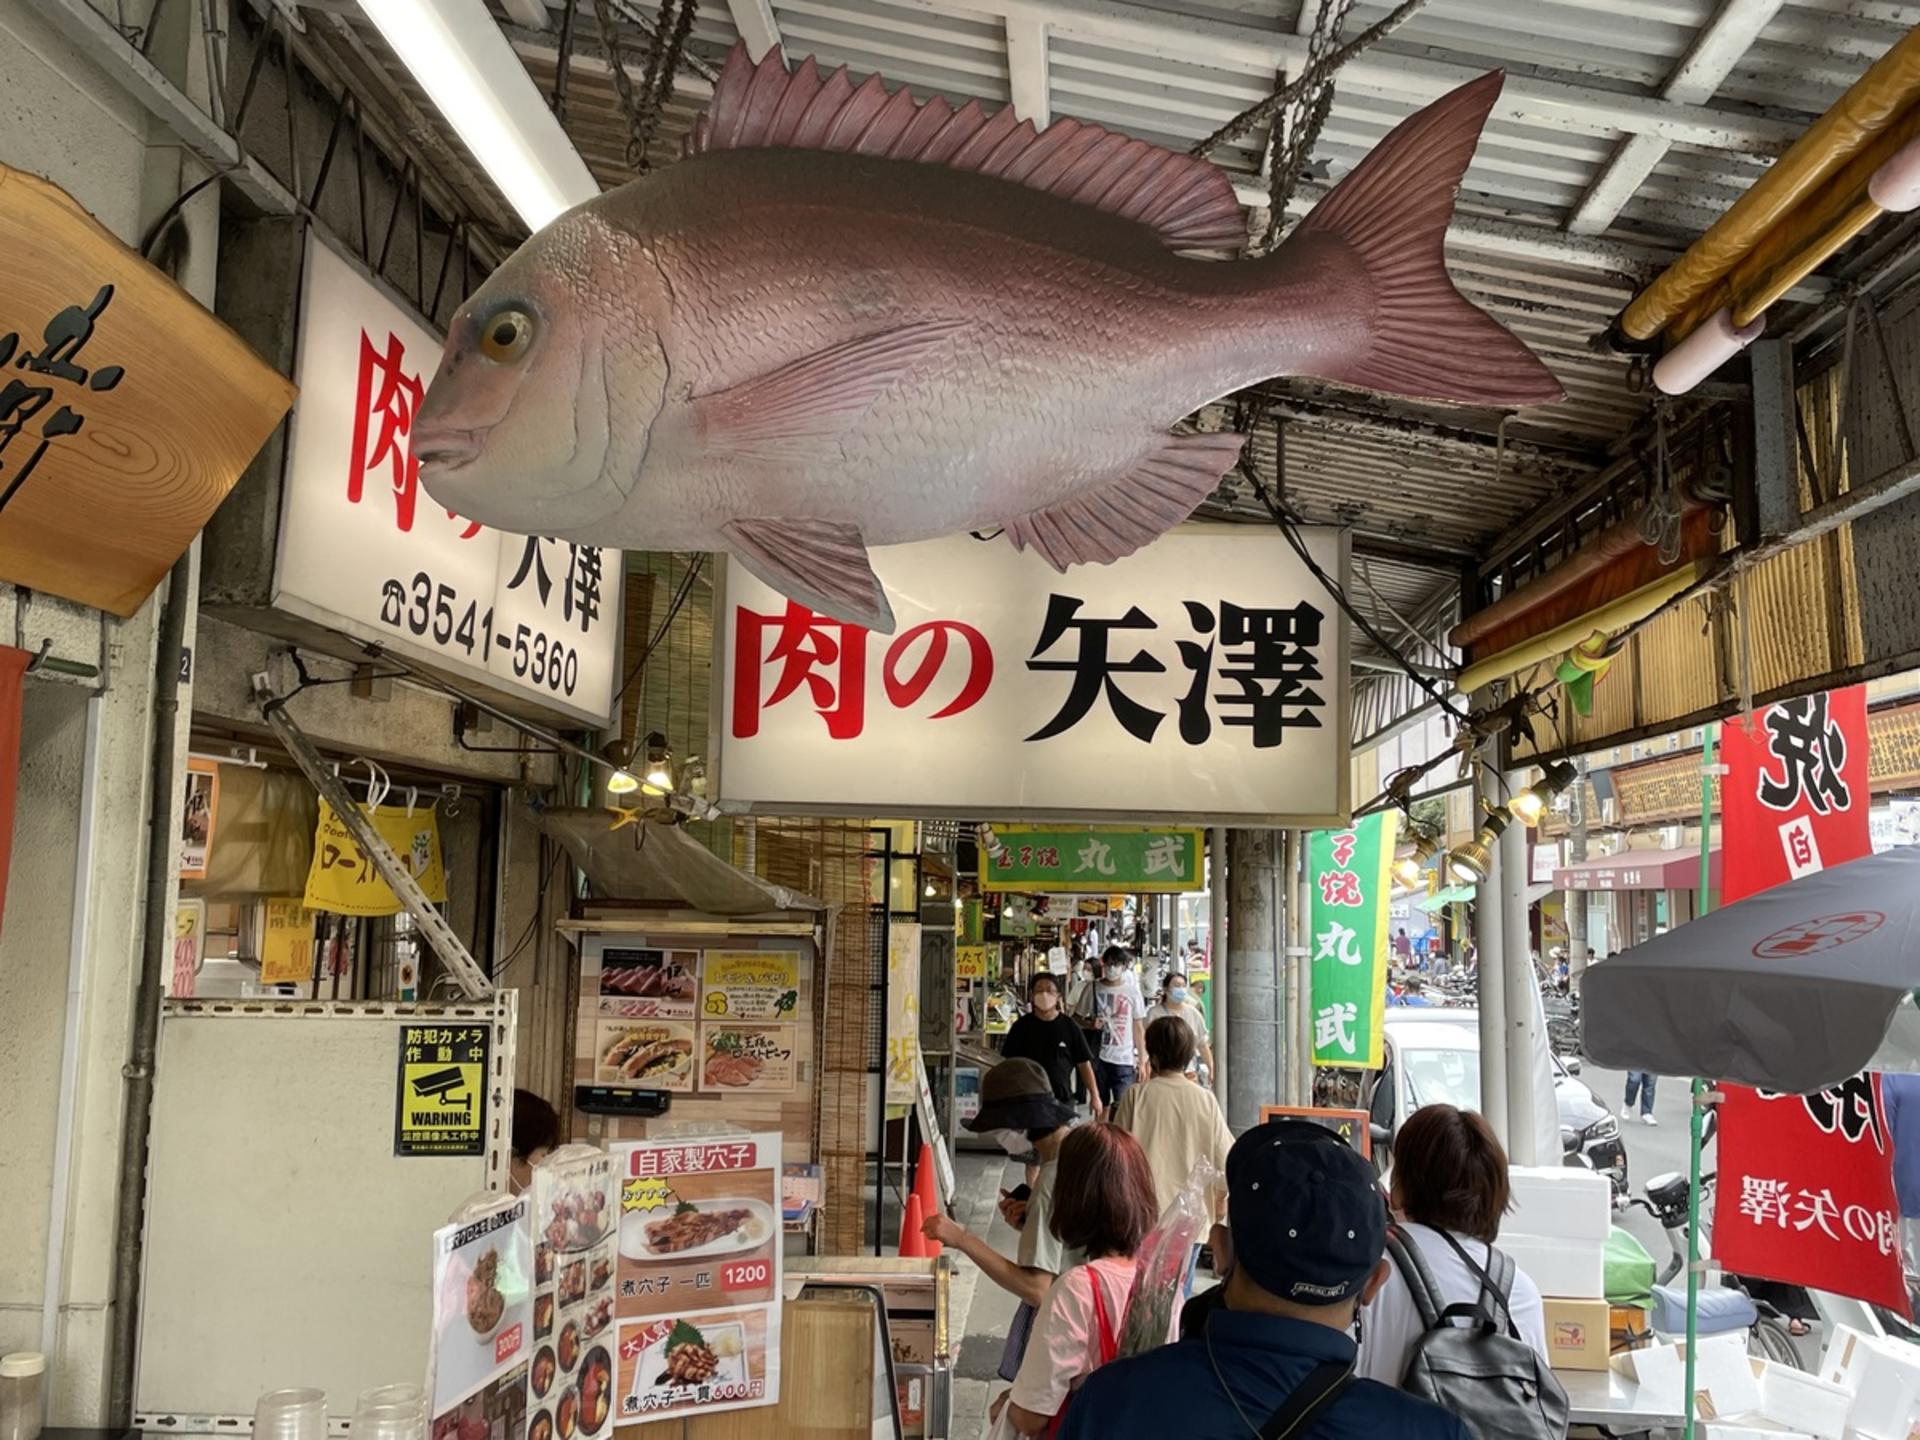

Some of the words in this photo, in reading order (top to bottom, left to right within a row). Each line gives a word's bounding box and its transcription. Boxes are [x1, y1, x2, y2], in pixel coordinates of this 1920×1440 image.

[408, 571, 577, 697] 3541-5360
[1073, 835, 1185, 877] 丸武
[1318, 817, 1364, 908] 子焼
[1313, 921, 1363, 1055] 丸武
[406, 1029, 484, 1045] 防犯カメラ
[732, 1047, 791, 1061] ローストビーフ
[411, 1111, 472, 1126] WARNING
[638, 1144, 751, 1176] 自家製穴子
[621, 1187, 668, 1201] おすすめ
[725, 1264, 766, 1284] 1200
[620, 1276, 672, 1297] 煮穴子
